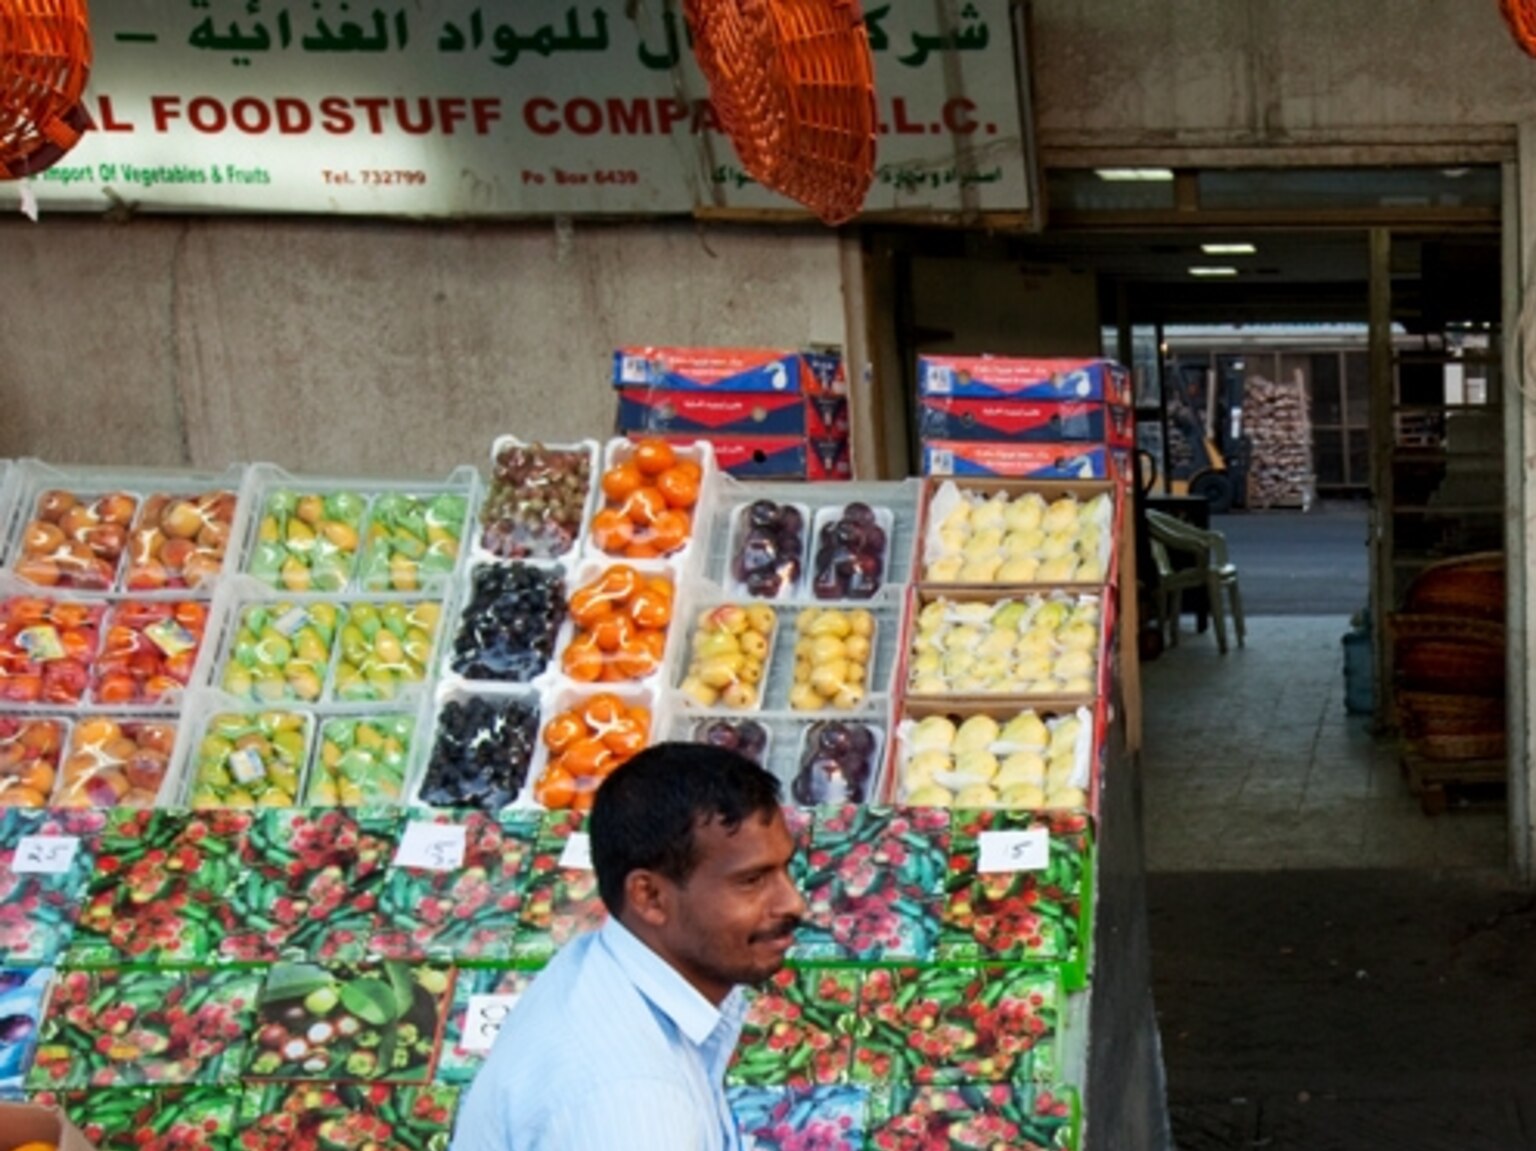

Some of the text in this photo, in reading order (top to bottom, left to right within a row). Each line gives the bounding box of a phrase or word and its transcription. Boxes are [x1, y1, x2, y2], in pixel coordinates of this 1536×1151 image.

[187, 0, 410, 67] الغذائية
[437, 6, 609, 69] للمواد
[150, 95, 504, 135] FOODSTUFF
[521, 97, 740, 136] COMPA
[120, 163, 206, 187] Vegetables
[211, 164, 223, 184] &
[226, 164, 271, 184] Fruits
[321, 169, 357, 186] Tel.
[554, 167, 588, 186] Box
[594, 169, 639, 187] 6439
